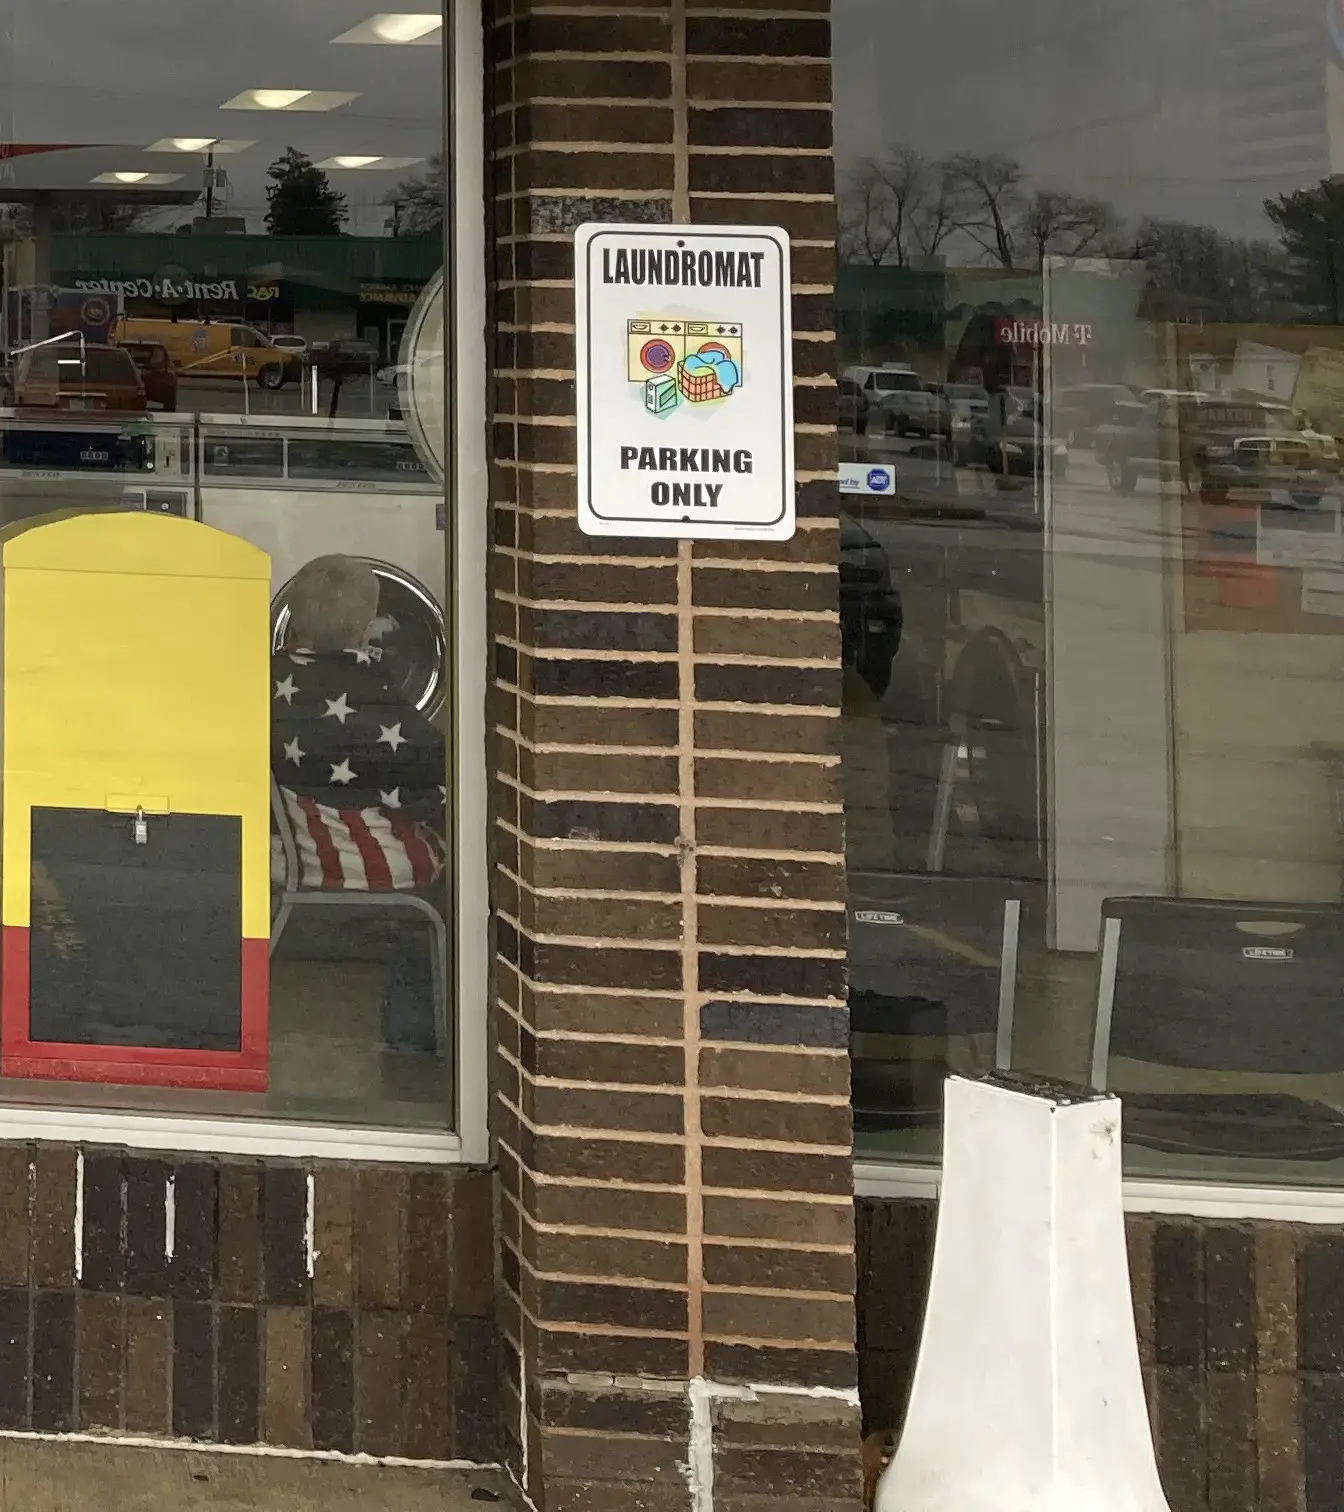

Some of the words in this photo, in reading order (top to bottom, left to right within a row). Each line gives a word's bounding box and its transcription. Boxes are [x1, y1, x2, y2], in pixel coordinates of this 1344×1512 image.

[603, 247, 765, 289] LAUNDROMAT
[620, 446, 753, 474] PARKING
[650, 482, 723, 508] ONLY
